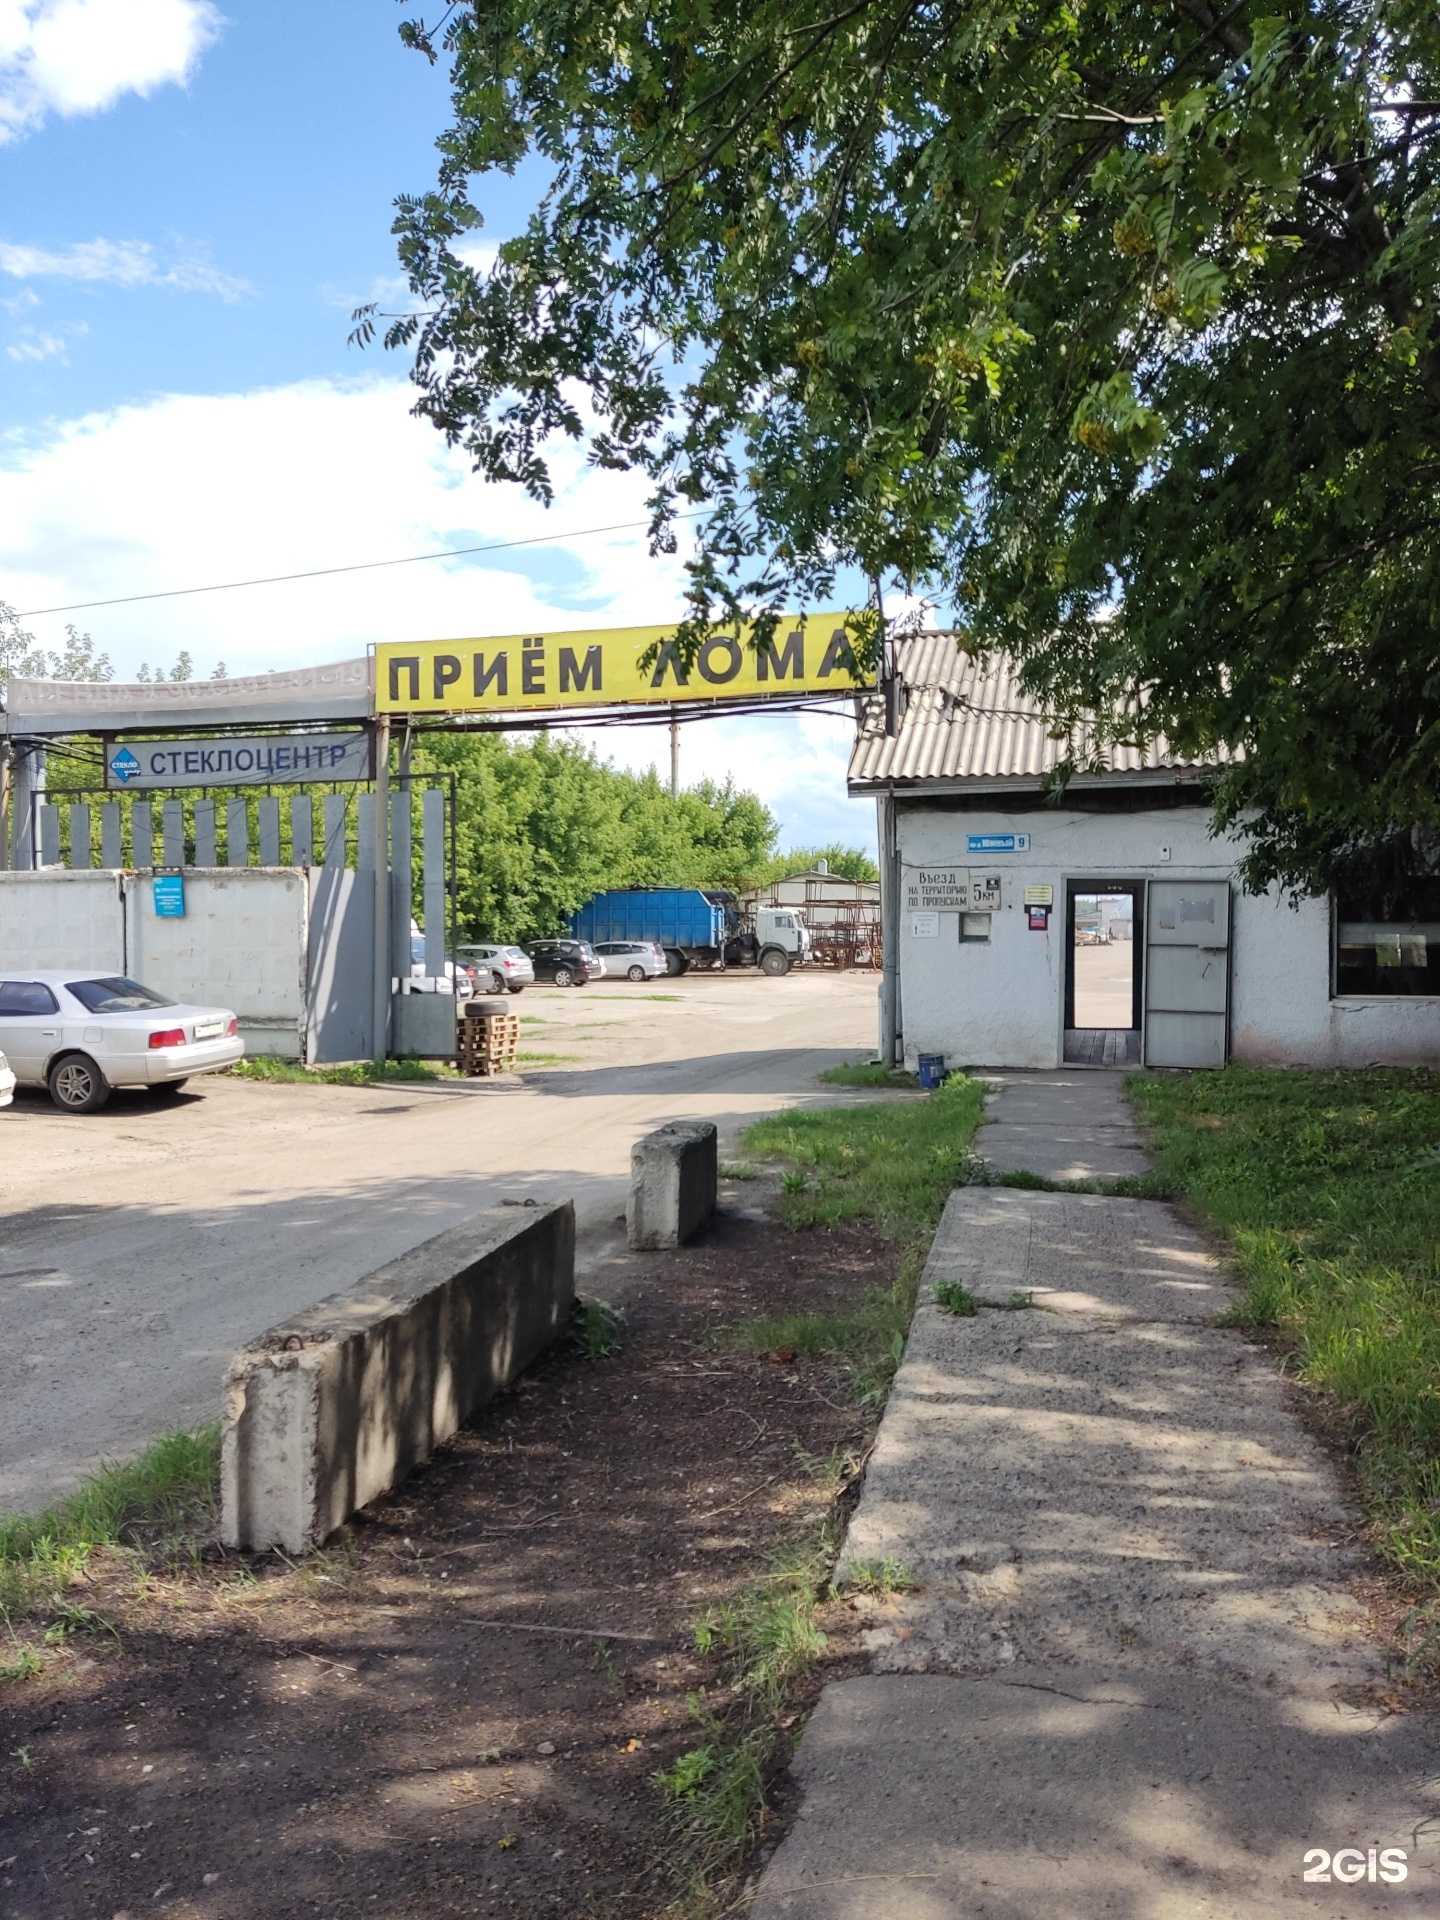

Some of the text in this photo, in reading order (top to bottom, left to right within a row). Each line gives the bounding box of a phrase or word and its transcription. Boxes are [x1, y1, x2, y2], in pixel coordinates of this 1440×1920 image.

[388, 637, 602, 701] ПРИЁМ
[650, 628, 862, 688] ЛОМА
[150, 745, 346, 775] СТЕКЛОЦЕНТР
[1018, 837, 1025, 848] 9
[919, 872, 956, 884] Въезд
[908, 885, 967, 895] НА ТЕРРИТОРИЮ
[908, 896, 967, 906] ПО ПРОПУСКАМ
